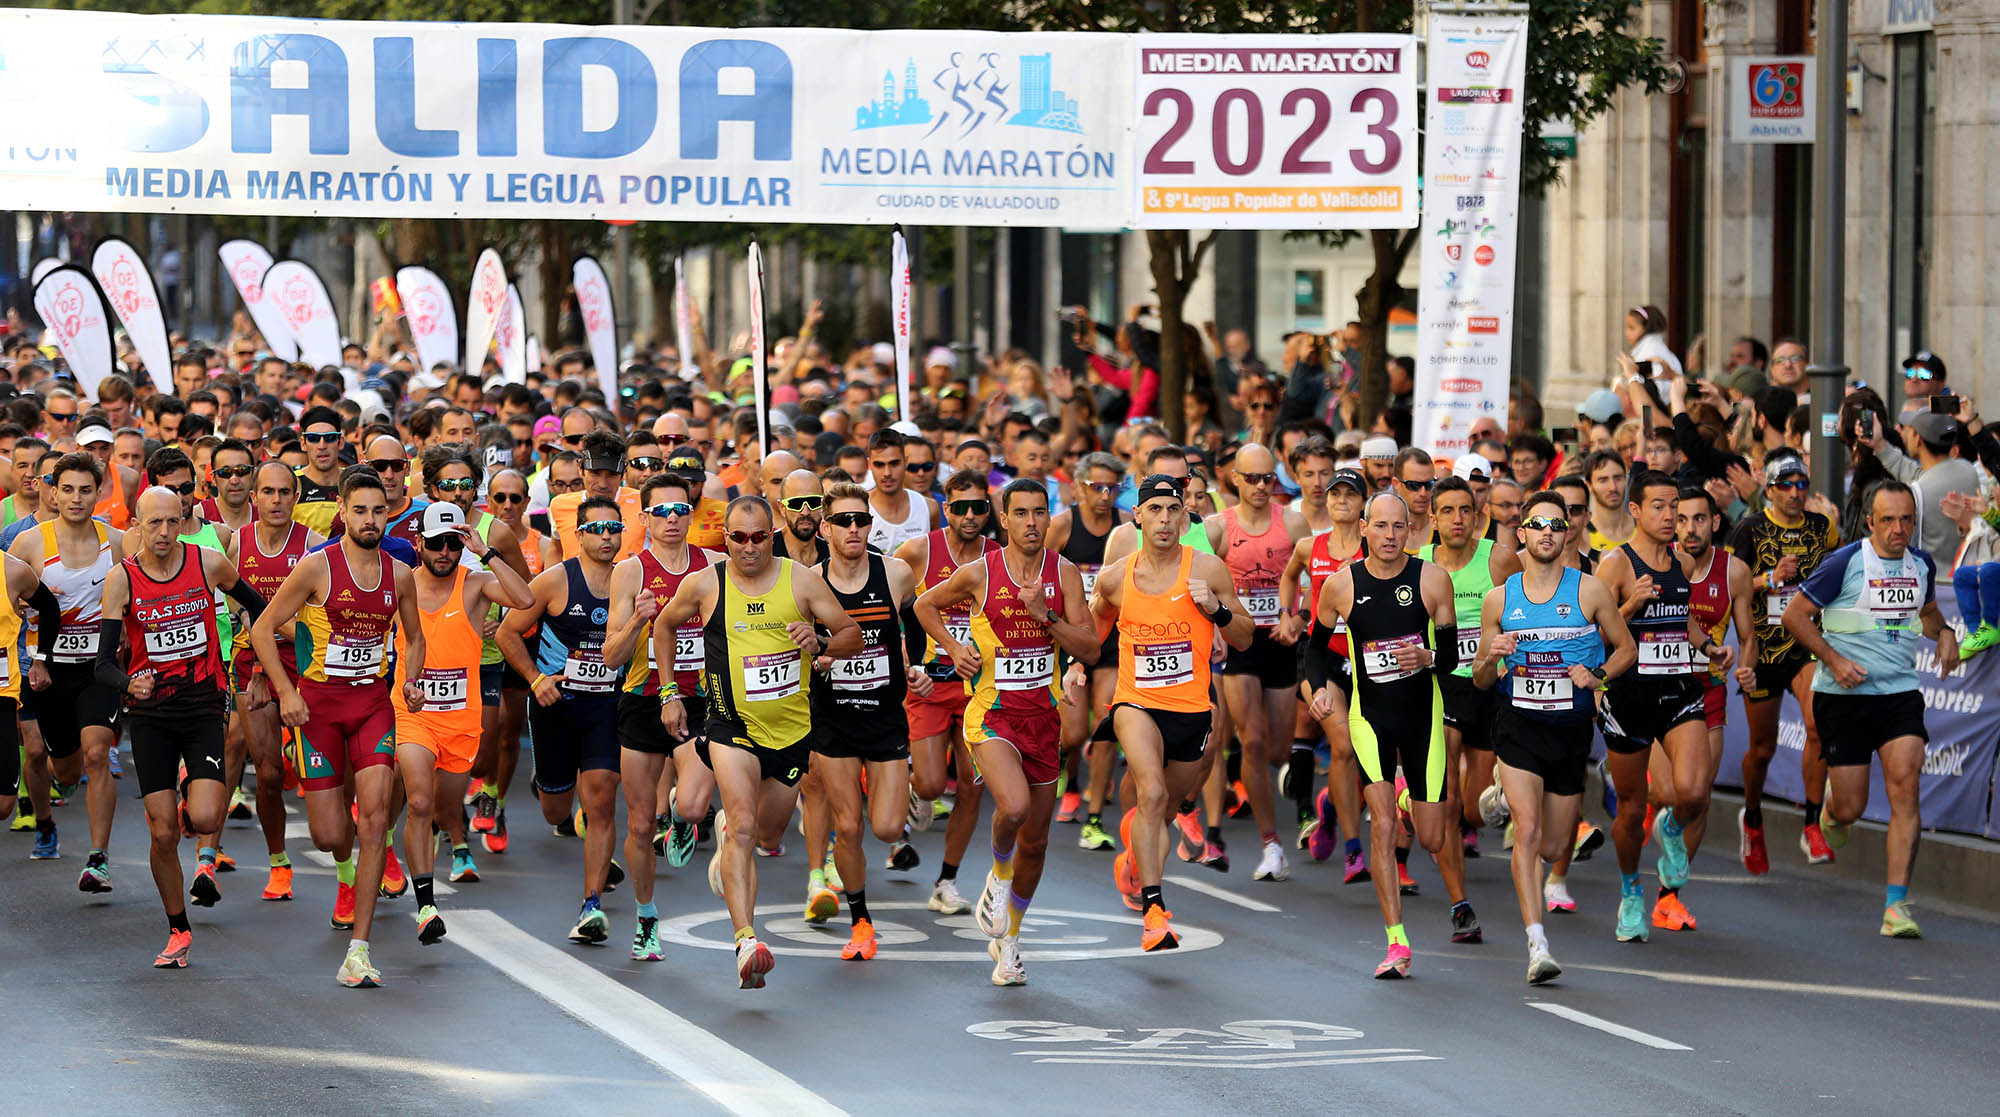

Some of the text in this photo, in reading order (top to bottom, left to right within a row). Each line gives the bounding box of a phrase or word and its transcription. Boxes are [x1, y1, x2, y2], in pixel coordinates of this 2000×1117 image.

[1149, 49, 1394, 72] MEDIA MARATÓN
[103, 33, 793, 161] SALIDA
[1142, 87, 1403, 176] 2023
[820, 144, 1115, 178] MEDIA MARATÓN
[105, 165, 792, 207] MEDIA MARATÓN Y LEGUA POPULAR
[876, 195, 1061, 211] CIUDAD DE VALLADOLID
[1147, 190, 1160, 208] &
[1184, 192, 1230, 211] Legua
[1234, 192, 1292, 210] Popular
[1300, 191, 1317, 208] de
[1320, 190, 1398, 208] Valladolid
[1435, 440, 1471, 449] MAP
[1878, 588, 1915, 603] 1204
[175, 598, 209, 615] SEGOVIA
[1249, 598, 1275, 612] 528
[154, 627, 198, 648] 1355
[1006, 629, 1020, 638] DE
[59, 635, 89, 650] 293
[674, 640, 695, 656] 62
[340, 647, 373, 663] 195
[1653, 643, 1682, 659] 104
[843, 659, 876, 676] 464
[1003, 658, 1047, 674] 1218
[1146, 655, 1180, 673] 353
[1377, 652, 1399, 668] 35
[577, 662, 607, 678] 590
[759, 664, 790, 684] 517
[711, 673, 726, 713] UNNERS
[1525, 679, 1556, 695] 871
[1920, 686, 1985, 714] portes
